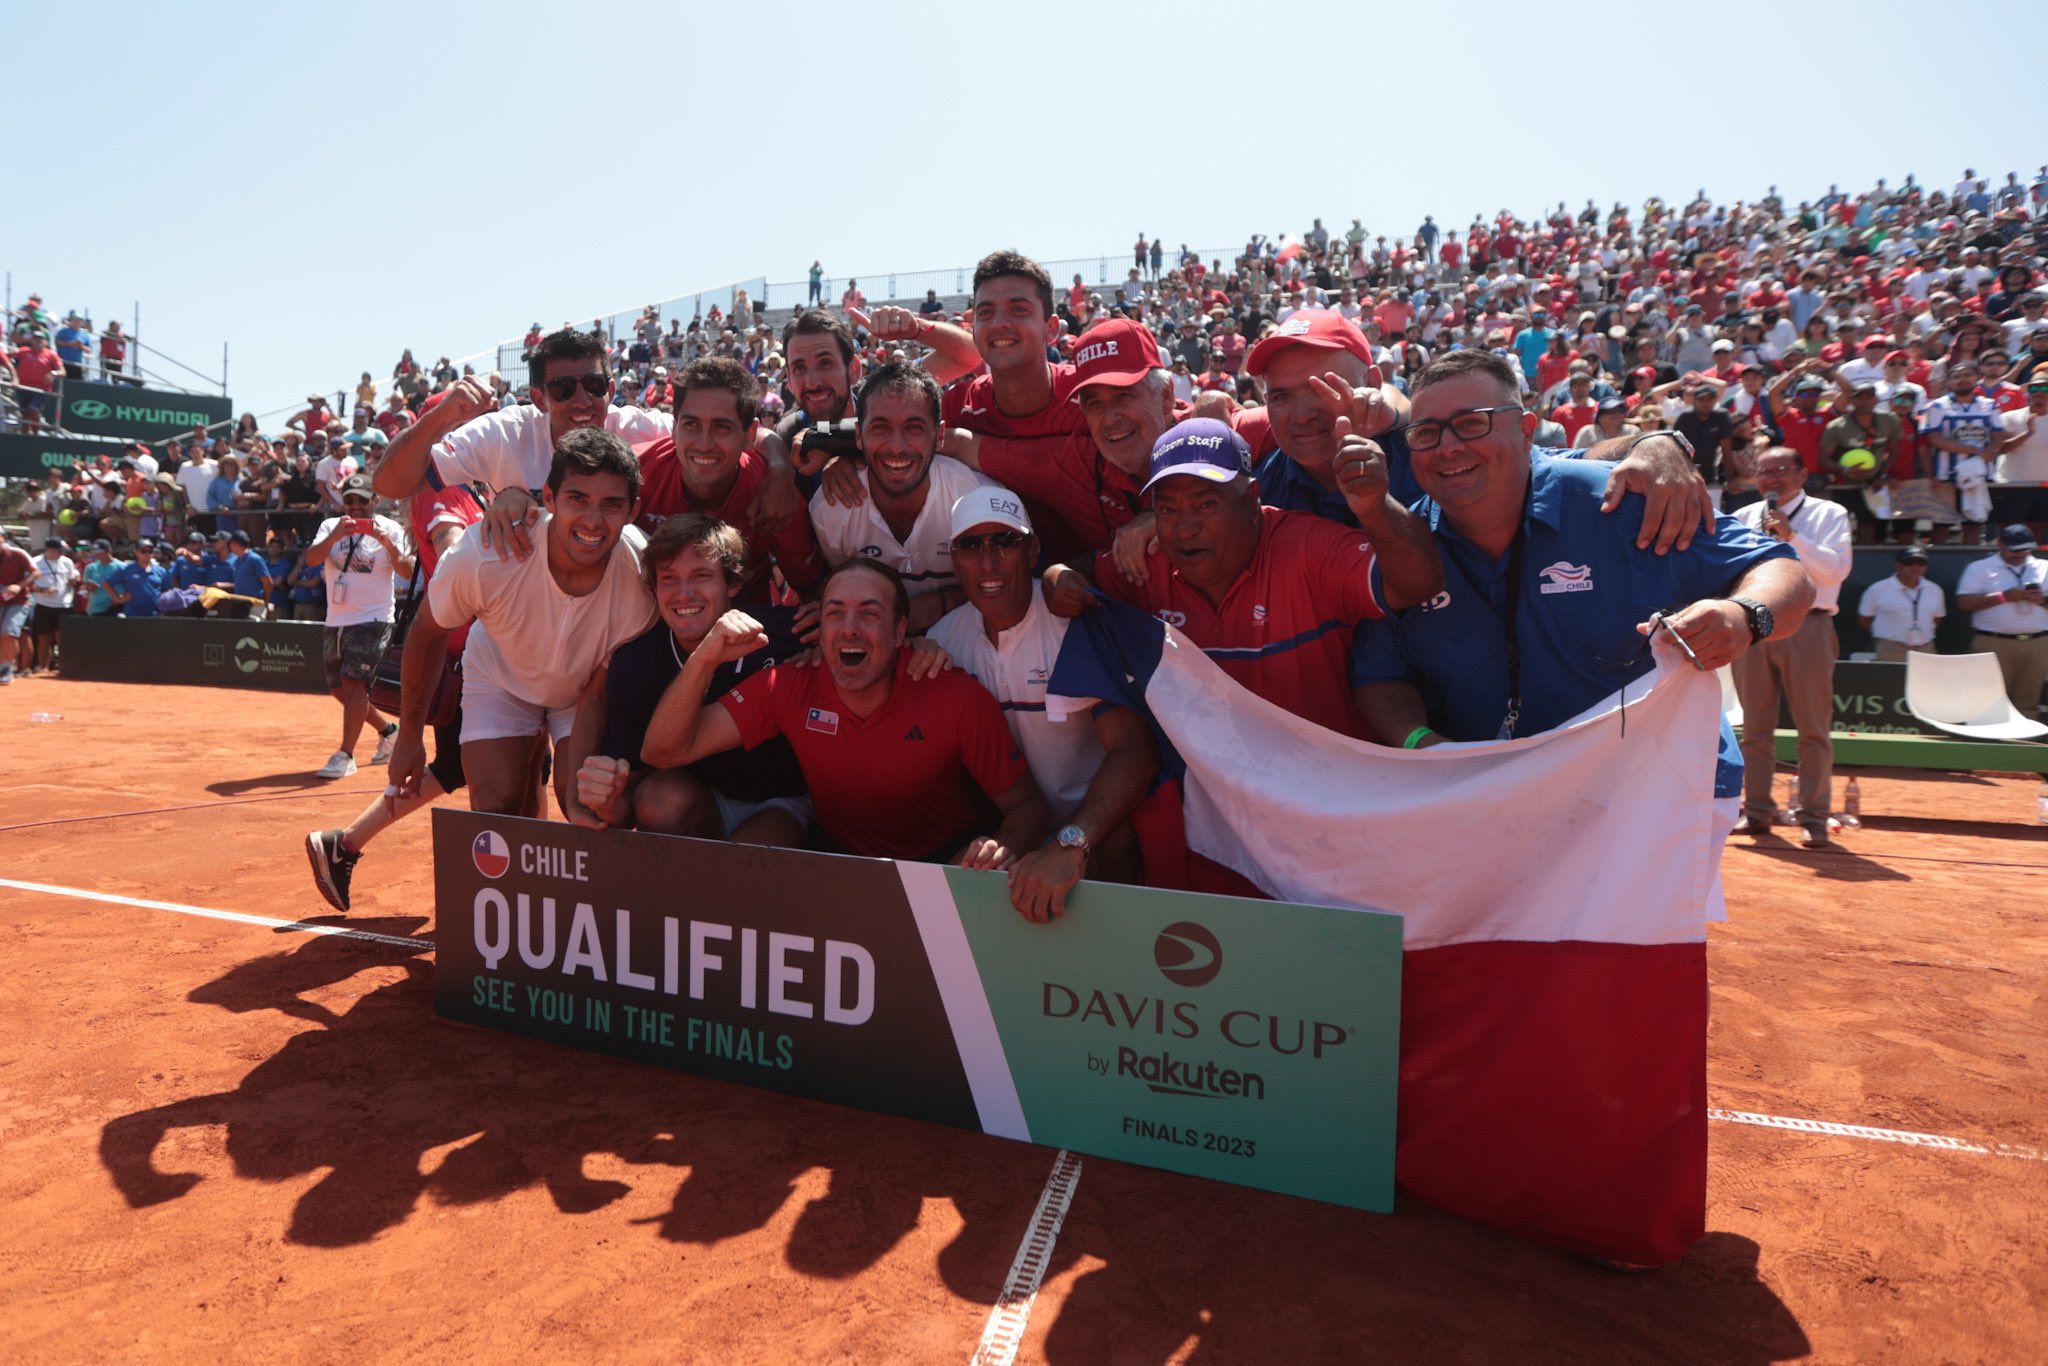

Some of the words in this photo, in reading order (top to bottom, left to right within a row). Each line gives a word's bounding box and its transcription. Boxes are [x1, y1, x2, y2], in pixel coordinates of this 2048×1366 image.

[1076, 341, 1119, 367] CHILE
[116, 405, 210, 426] HYUNDAI
[1187, 435, 1223, 449] Staff
[990, 498, 1019, 515] EA7
[1566, 582, 1590, 590] CHILE
[520, 843, 589, 882] CHILE
[473, 887, 876, 1026] QUALIFIED
[472, 974, 516, 1014] SEE
[526, 985, 575, 1025] YOU
[586, 997, 610, 1034] IN
[623, 1005, 675, 1048] THE
[688, 1018, 795, 1071] FINALS
[1042, 982, 1200, 1039] DAVIS
[1087, 1051, 1111, 1077] by
[1117, 1045, 1265, 1101] Rakuten
[1122, 1117, 1198, 1148] FINALS
[1203, 1131, 1256, 1158] 2023
